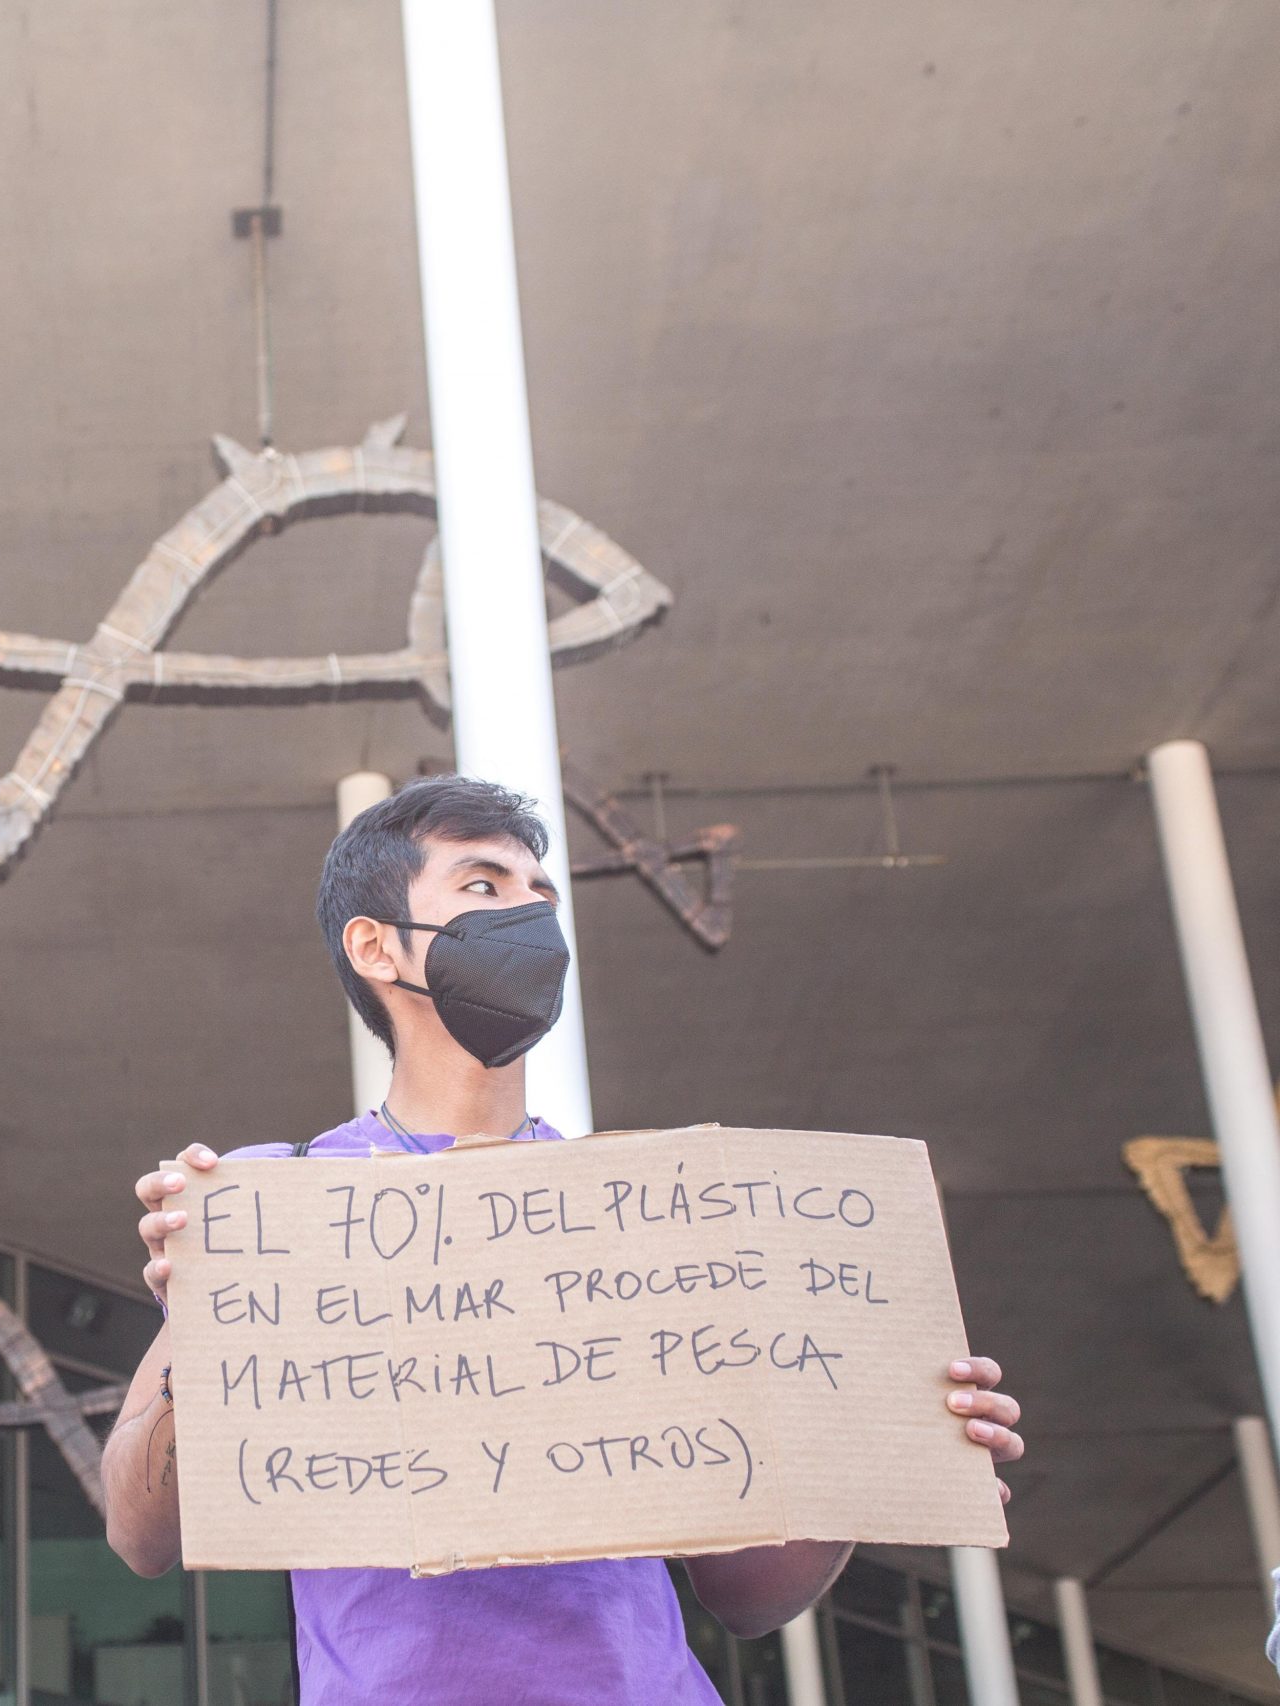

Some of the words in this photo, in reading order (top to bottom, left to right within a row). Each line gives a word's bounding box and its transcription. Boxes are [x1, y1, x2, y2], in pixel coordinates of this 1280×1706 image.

[202, 1184, 290, 1255] EL
[478, 1188, 596, 1241] DEL
[209, 1282, 280, 1326] EN
[315, 1284, 393, 1327] EL
[405, 1279, 516, 1325] MAR
[544, 1250, 768, 1313] PROCEDE
[799, 1257, 889, 1305] DEL
[535, 1336, 622, 1386] DE
[650, 1323, 844, 1391] PESCA
[238, 1438, 449, 1505] (REDES
[481, 1441, 510, 1493] Y
